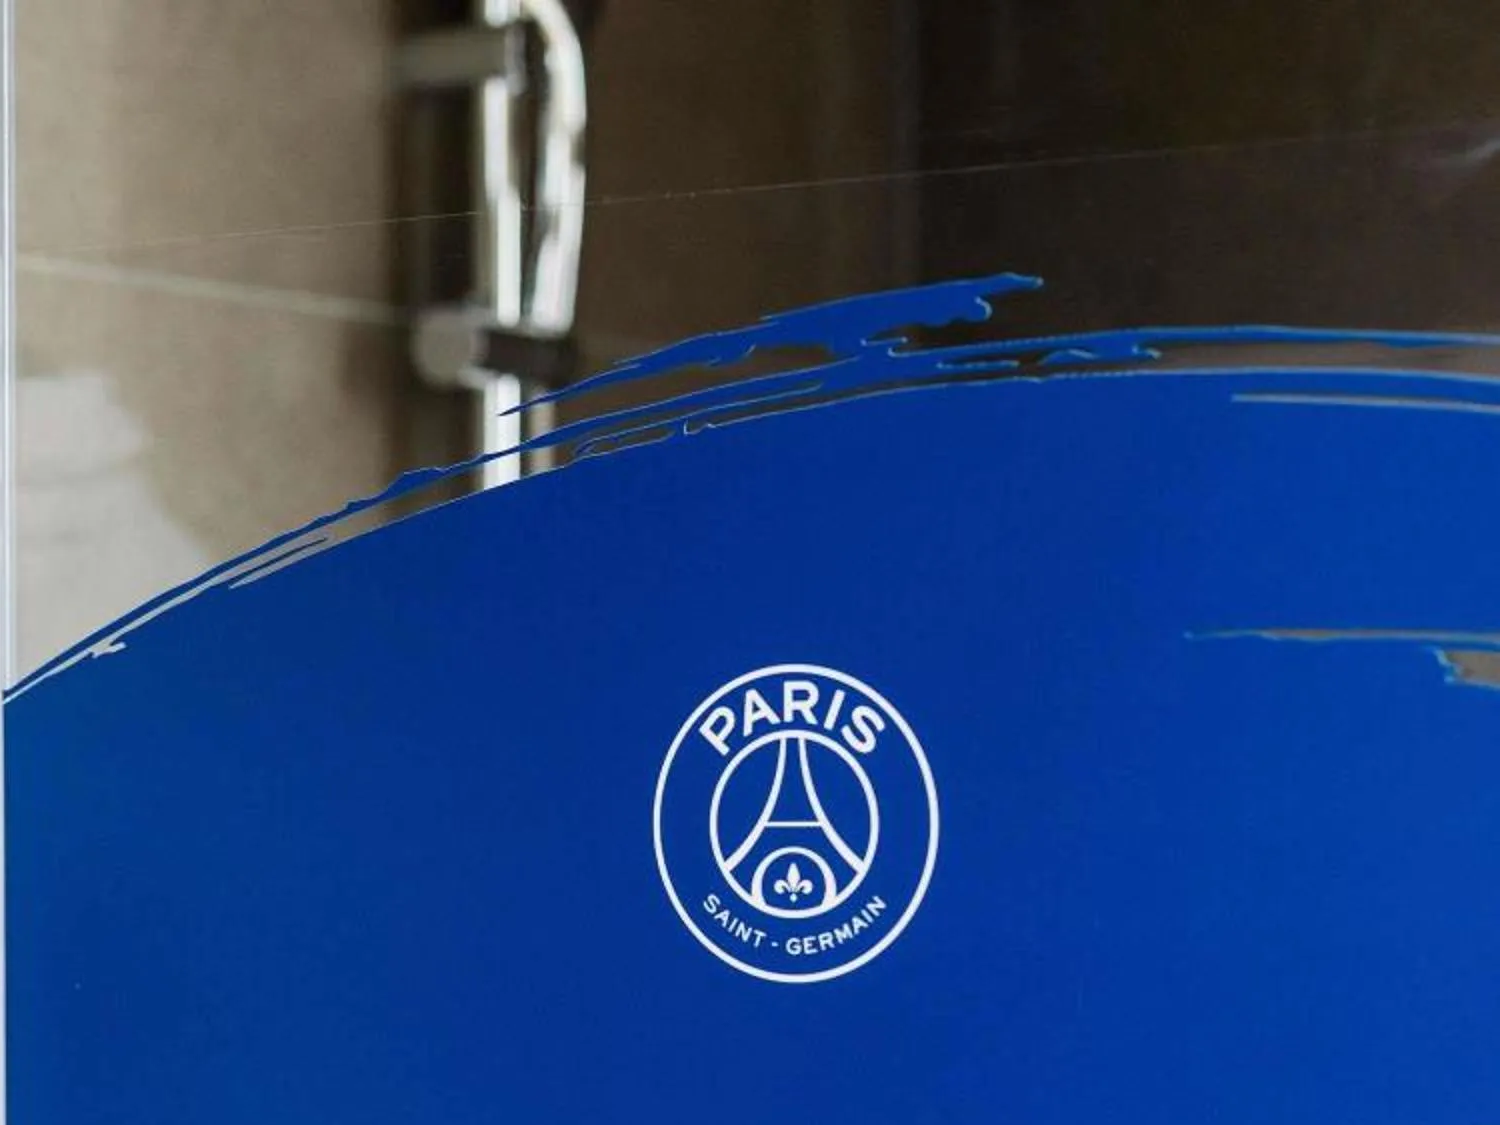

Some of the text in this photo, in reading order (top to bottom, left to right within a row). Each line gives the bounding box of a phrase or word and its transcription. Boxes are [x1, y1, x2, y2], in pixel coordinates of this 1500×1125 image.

[698, 679, 887, 757] PARIS
[702, 893, 767, 948] SAINT
[785, 895, 888, 956] GERMAIN
